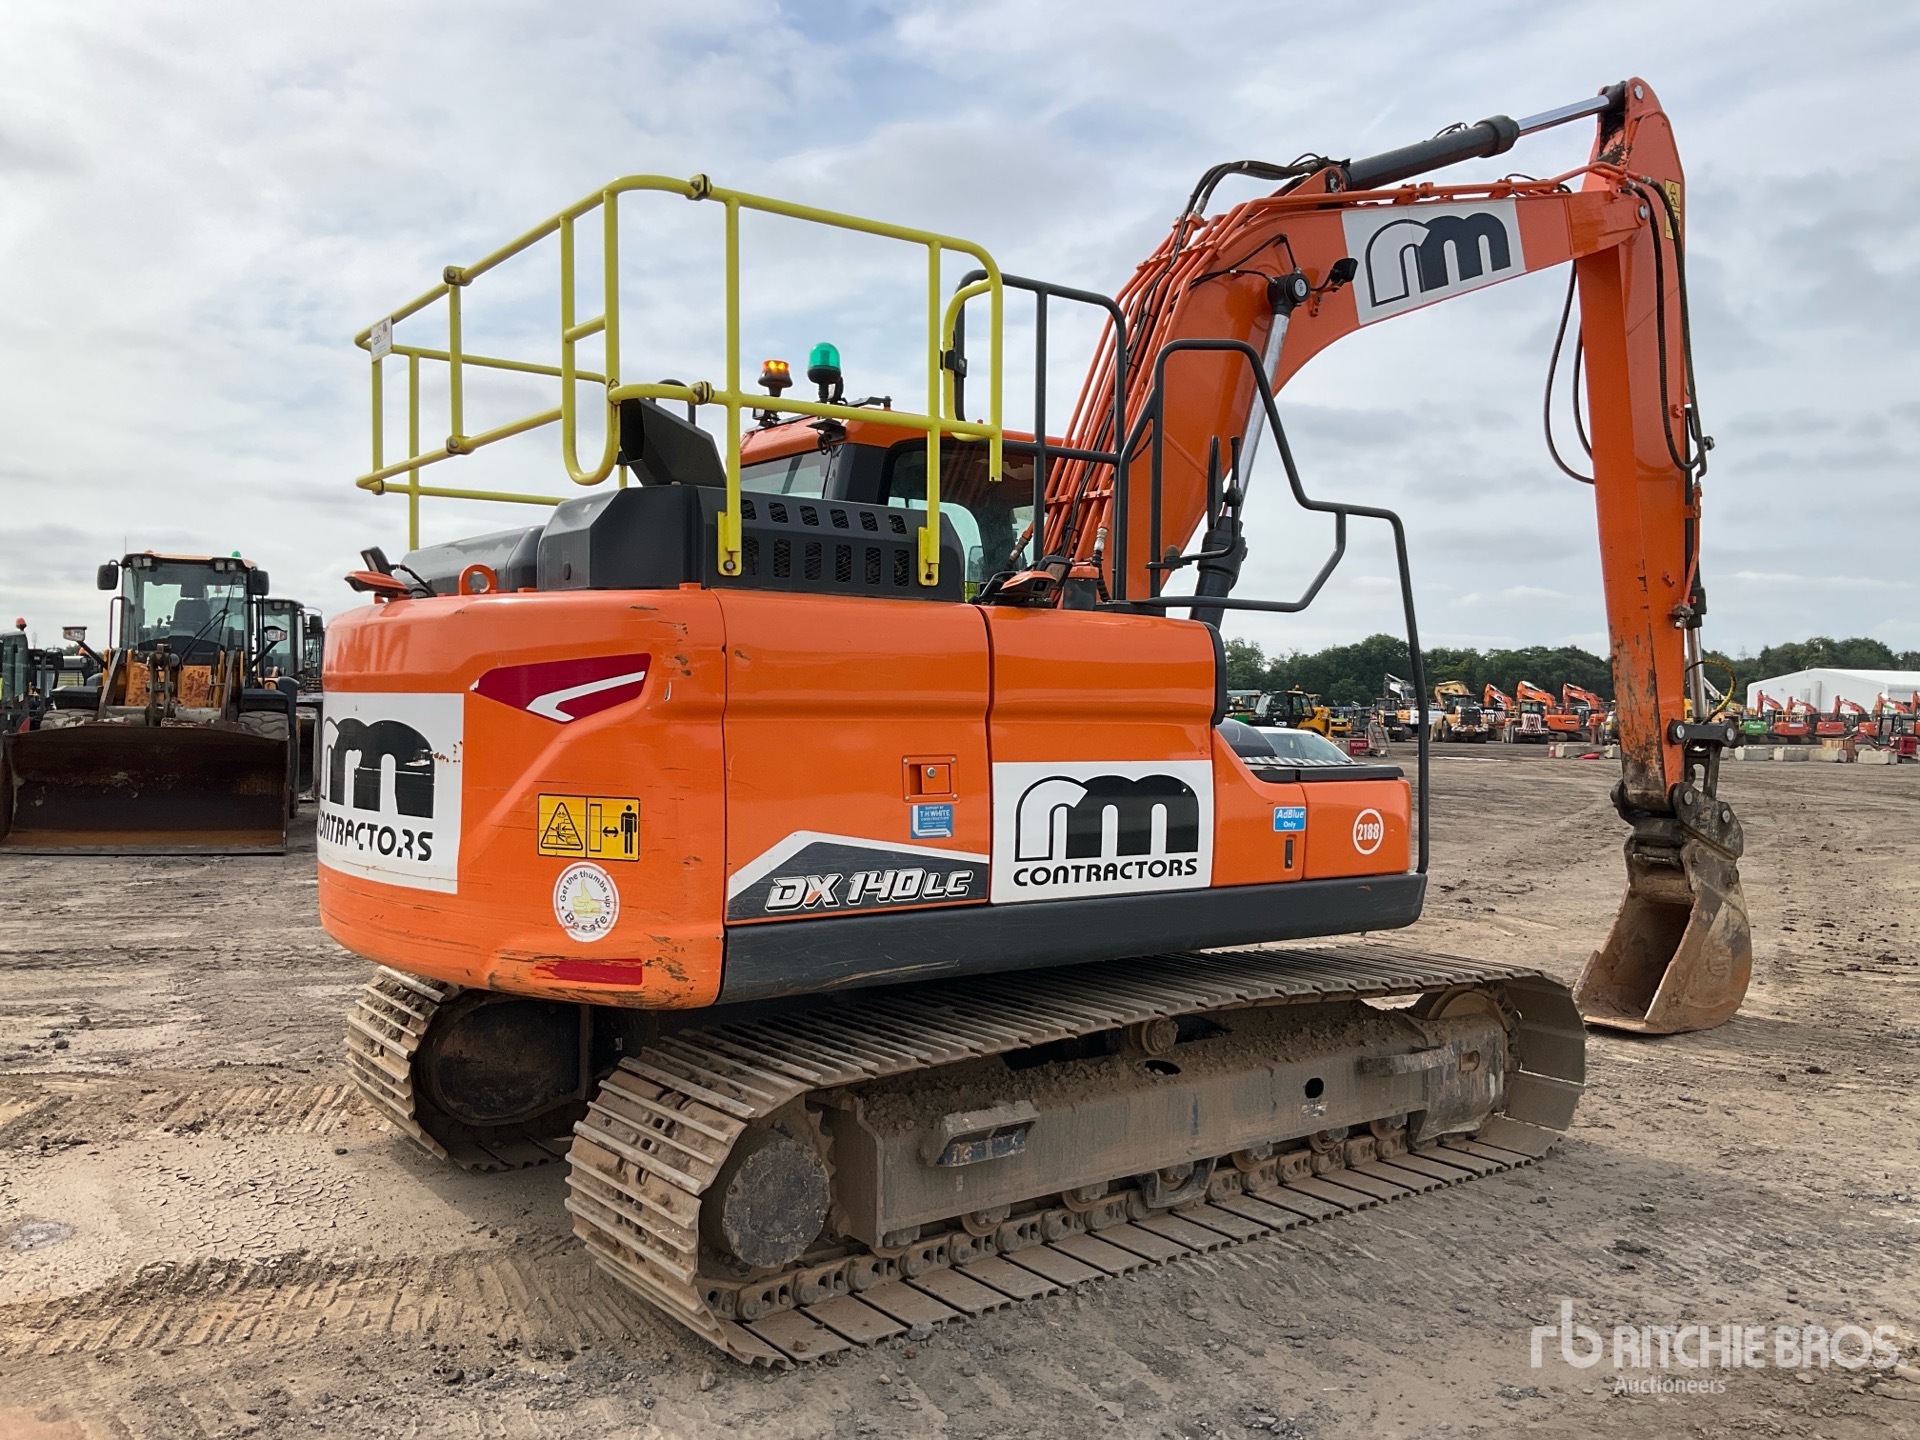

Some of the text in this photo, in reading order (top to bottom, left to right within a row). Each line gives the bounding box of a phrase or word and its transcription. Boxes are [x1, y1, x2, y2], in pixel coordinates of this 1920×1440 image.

[1277, 809, 1304, 819] AdBlue
[1283, 820, 1297, 829] Only
[1357, 823, 1380, 841] 2188
[1013, 858, 1198, 887] CONTRACTORS
[560, 870, 611, 908] Get the thumbs up
[765, 874, 843, 912] DX
[564, 911, 580, 930] Be
